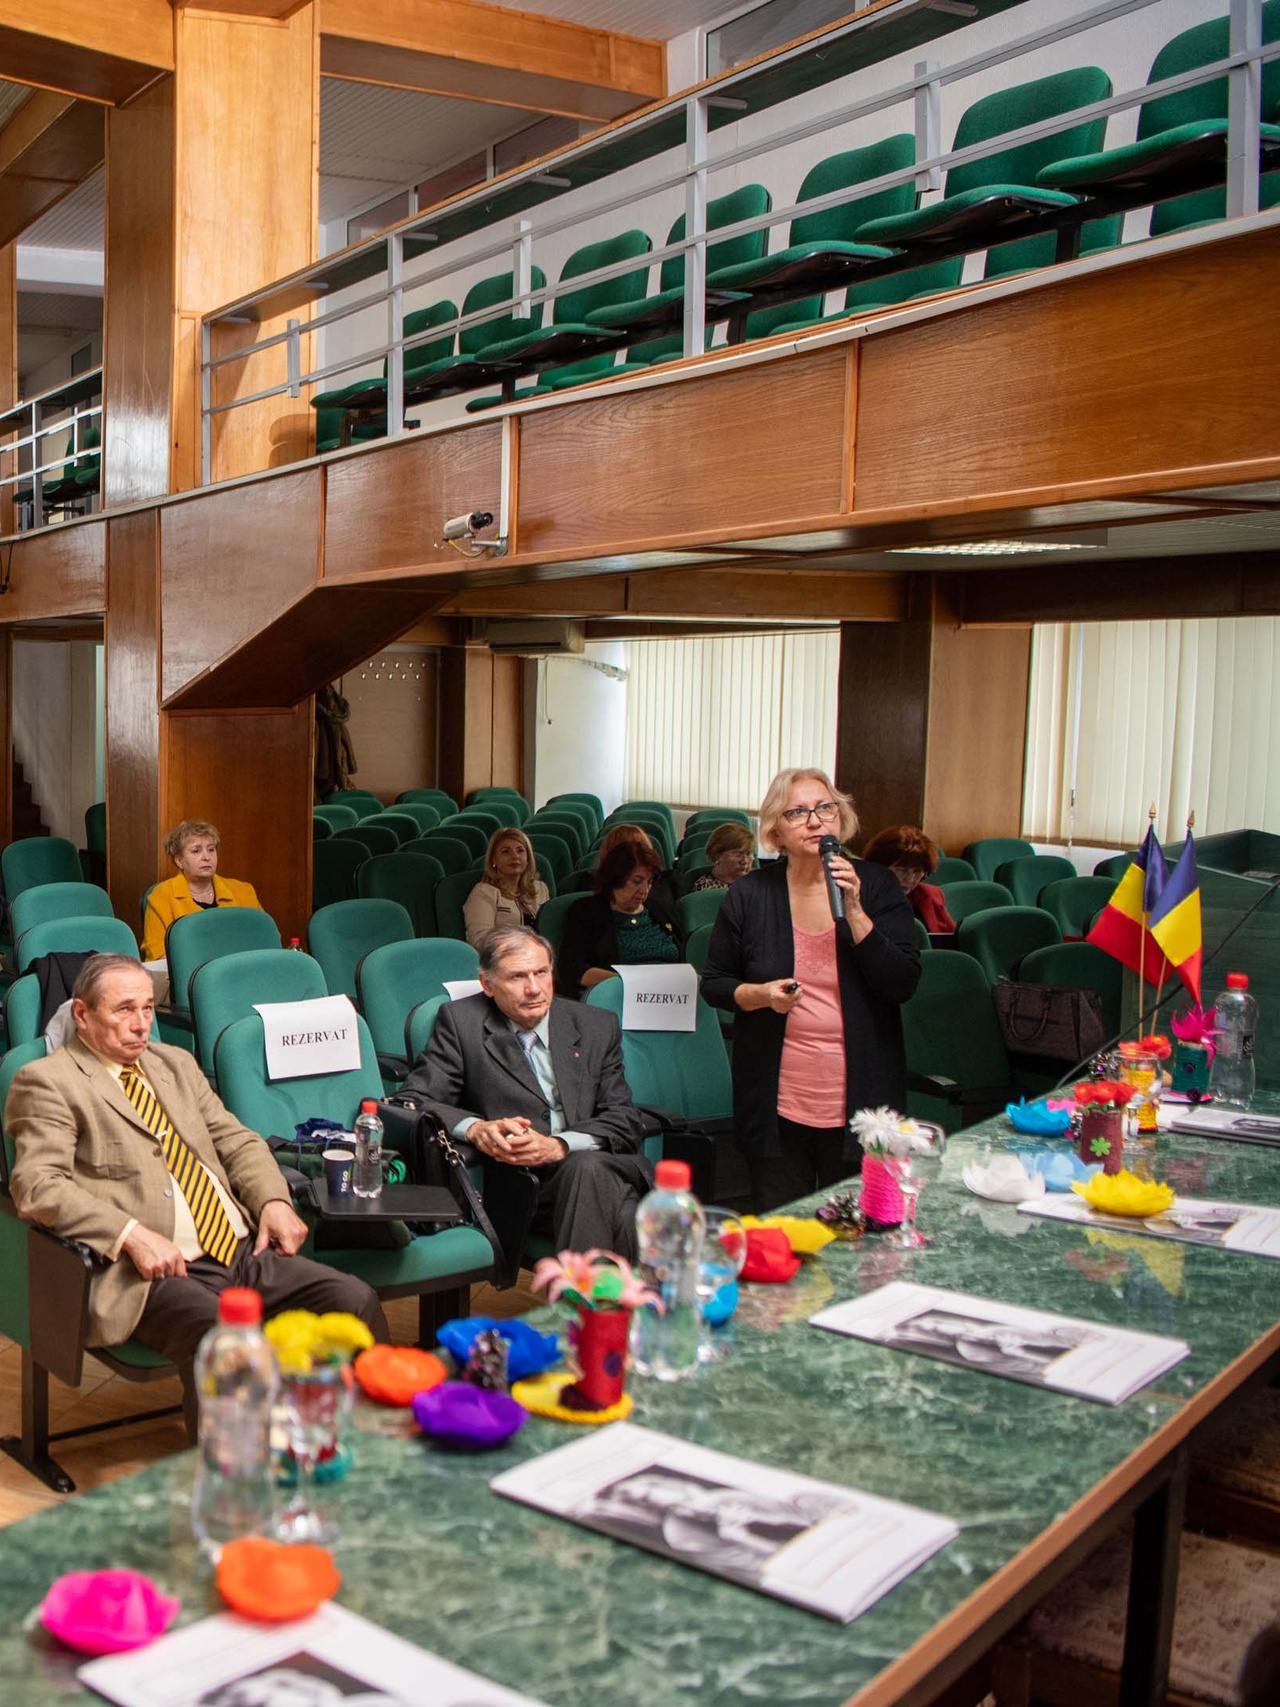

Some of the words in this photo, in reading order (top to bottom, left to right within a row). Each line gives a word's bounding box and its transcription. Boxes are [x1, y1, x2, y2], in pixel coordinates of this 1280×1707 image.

[636, 992, 689, 1005] REZERVAT
[282, 1028, 347, 1046] REZERVAT
[342, 1170, 349, 1182] GO
[340, 1182, 348, 1194] TO
